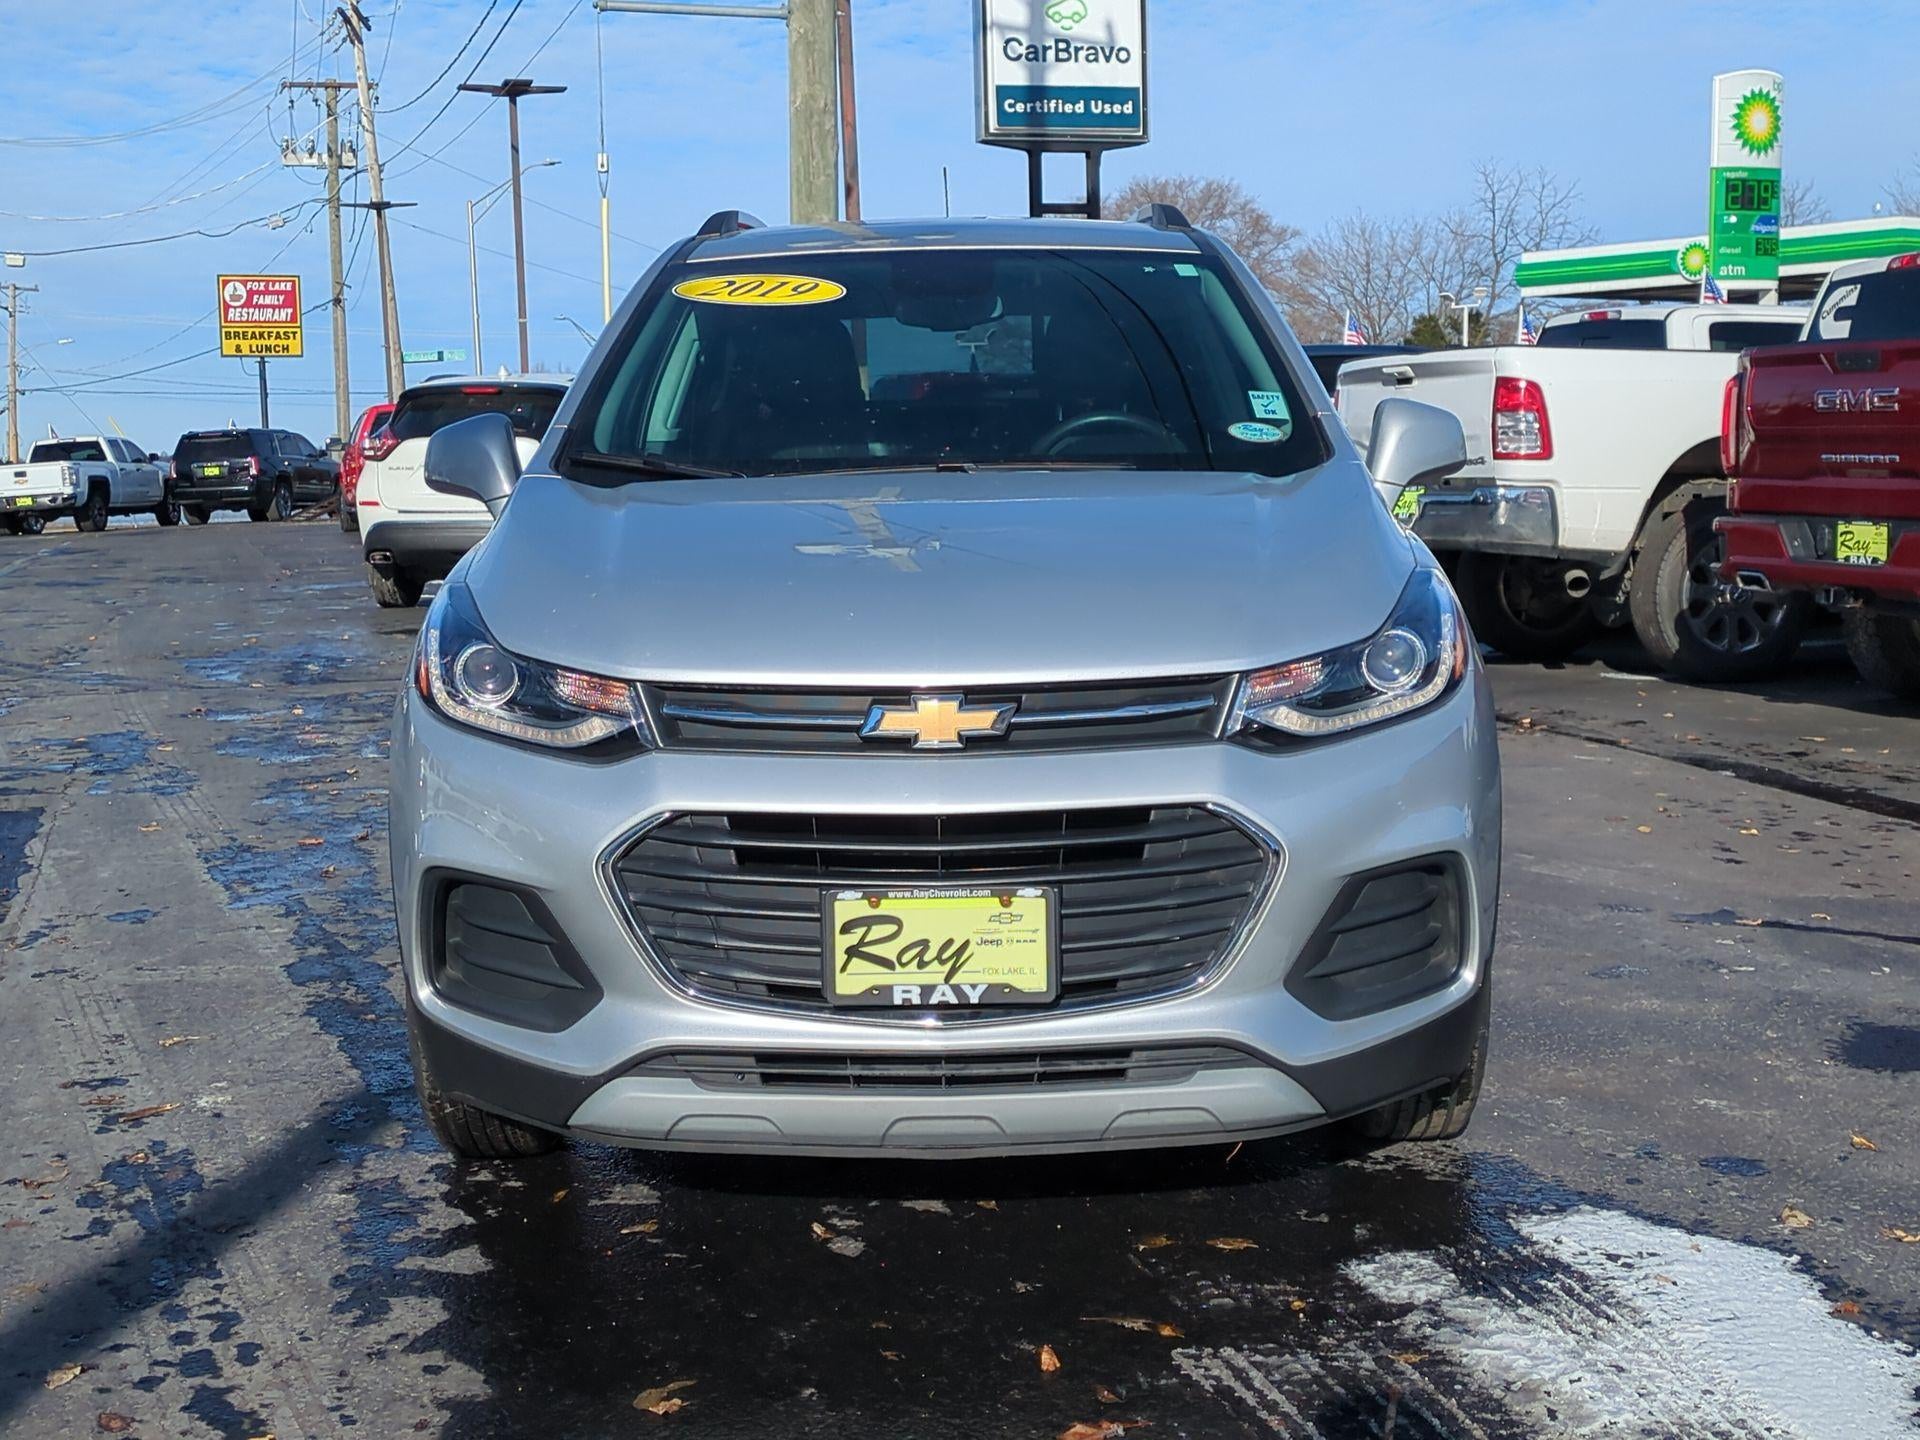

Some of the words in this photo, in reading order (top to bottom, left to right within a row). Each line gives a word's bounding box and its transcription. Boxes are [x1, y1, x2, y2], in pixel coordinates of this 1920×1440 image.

[1003, 37, 1131, 63] CarBravo
[1003, 98, 1085, 114] Certified
[1091, 99, 1133, 115] Used
[1719, 264, 1746, 276] atm
[246, 281, 265, 291] FOX
[268, 281, 292, 291] LAKE
[696, 279, 820, 298] 2019
[253, 294, 285, 305] FAMILY
[227, 307, 293, 321] RESTAURANT
[224, 331, 298, 340] BREAKFAST
[235, 344, 243, 353] &
[249, 344, 289, 353] LUNCH
[1814, 387, 1899, 412] GMC
[1840, 530, 1871, 557] Ray
[1850, 556, 1873, 565] RAY
[888, 888, 991, 899] www.RayChevrolet.com
[976, 937, 1002, 947] Jeep
[839, 914, 974, 984] Ray
[982, 967, 1000, 975] FOX
[1029, 967, 1037, 975] IL
[892, 984, 989, 1005] RAY
